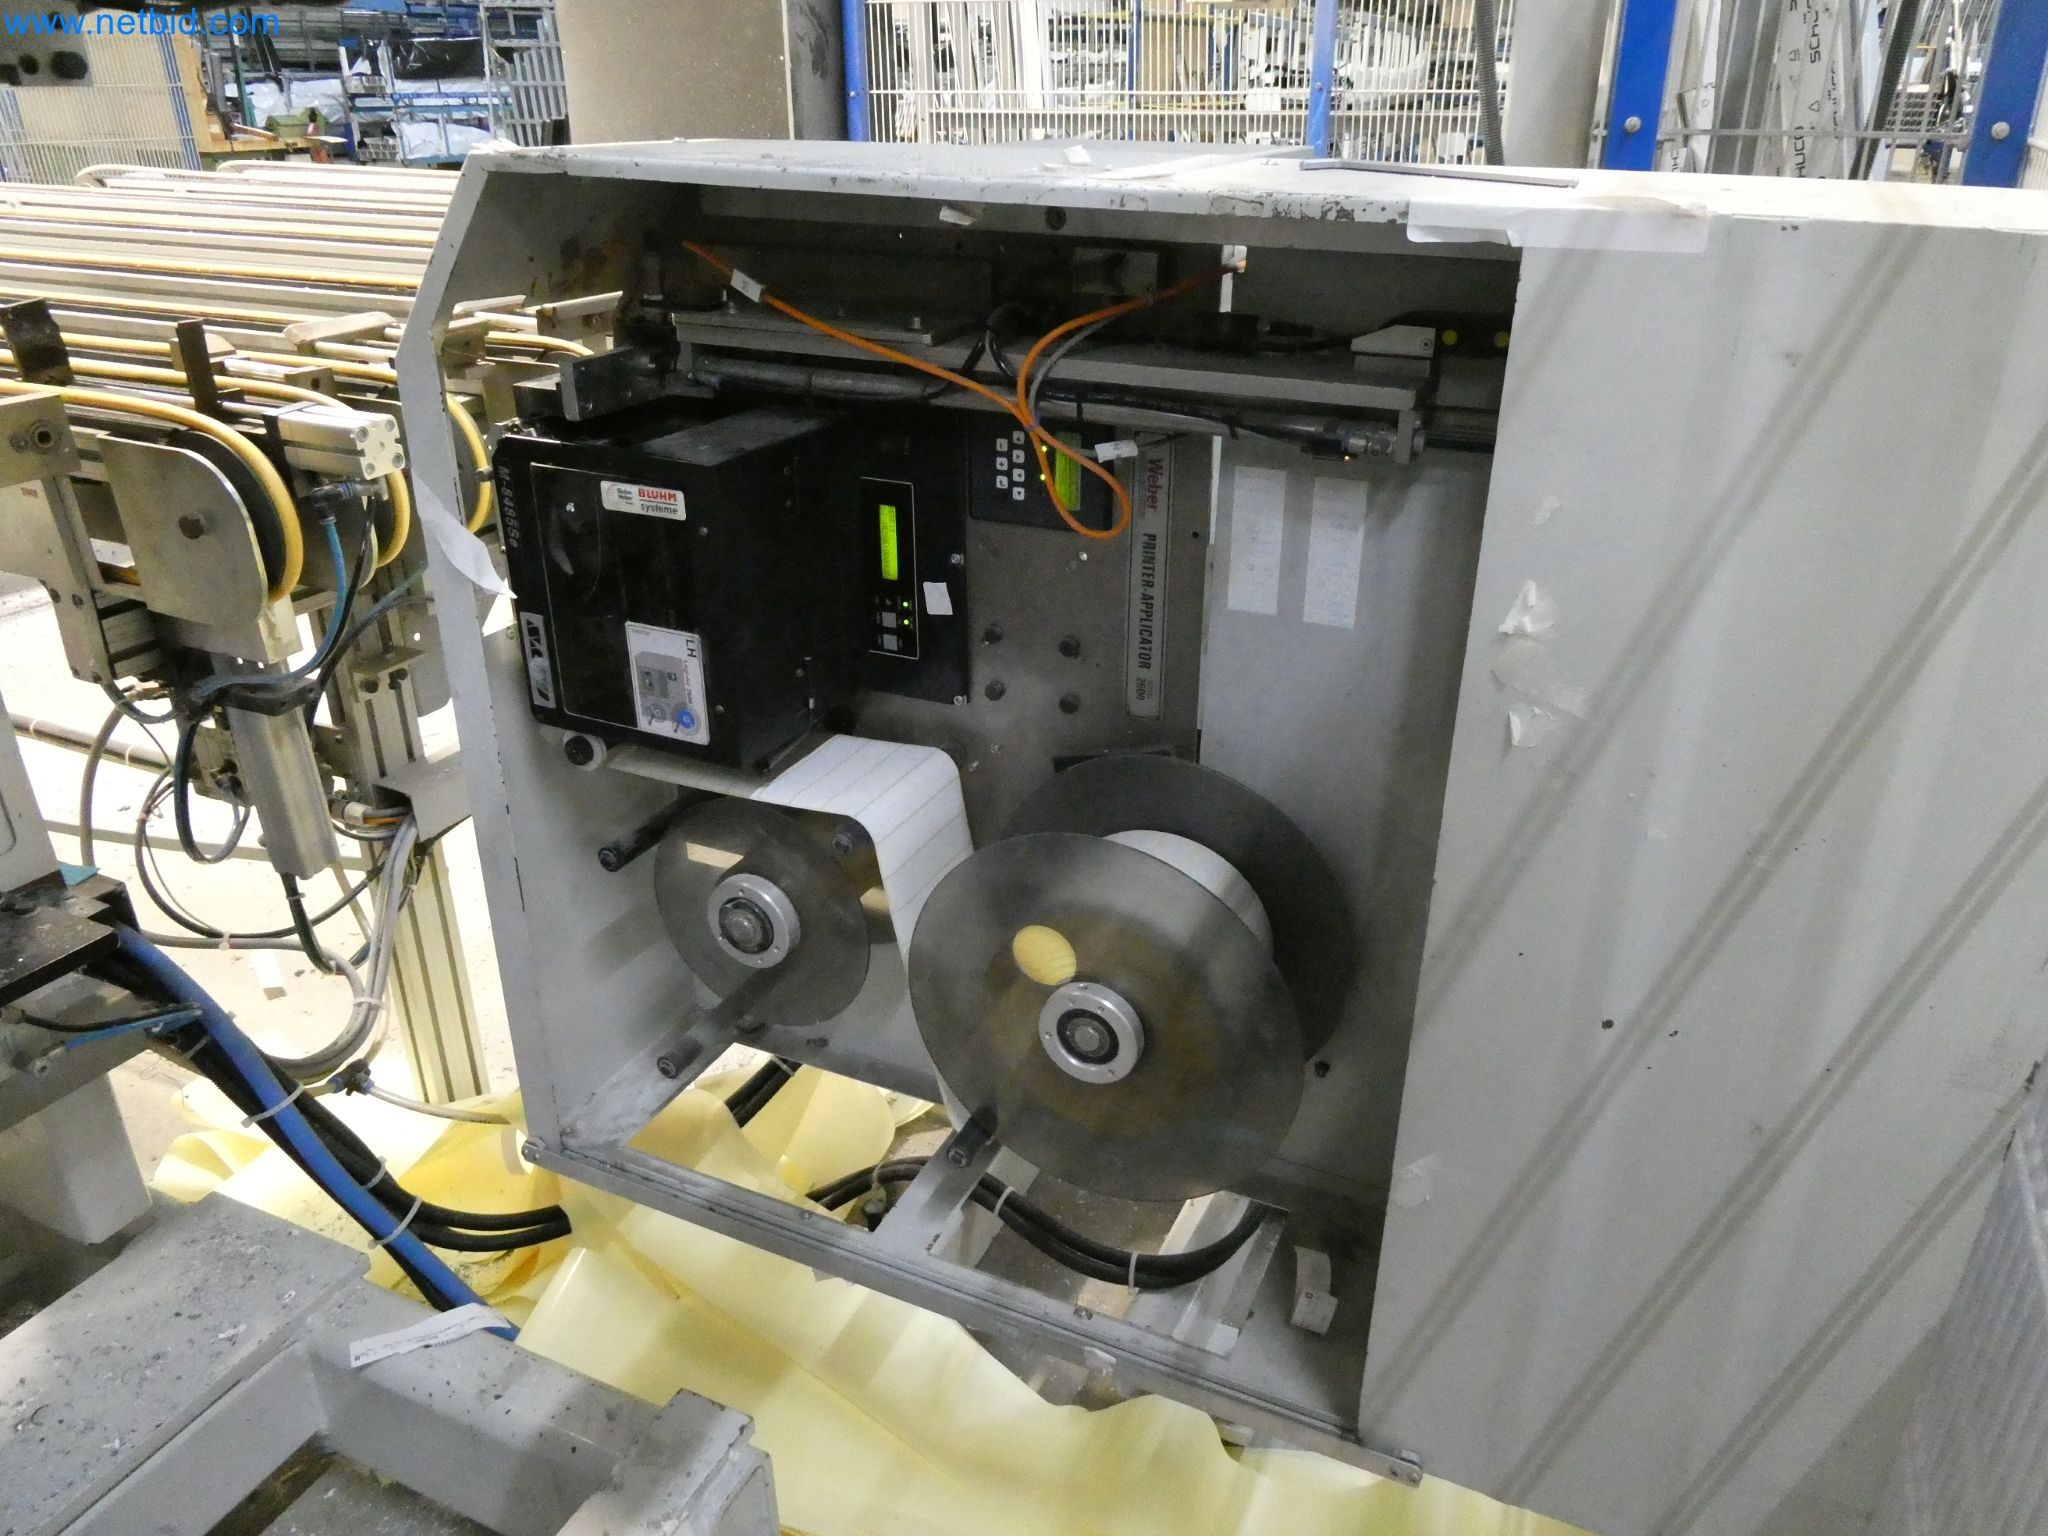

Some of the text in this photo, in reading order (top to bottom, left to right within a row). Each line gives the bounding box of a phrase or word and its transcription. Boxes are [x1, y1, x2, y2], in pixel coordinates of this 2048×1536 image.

[638, 488, 678, 502] BLUHM
[1147, 459, 1164, 511] Weber
[640, 503, 678, 515] systeme
[1138, 533, 1157, 670] PRINTER-APPLICATOR
[686, 639, 697, 658] LH
[1136, 677, 1146, 701] 2600
